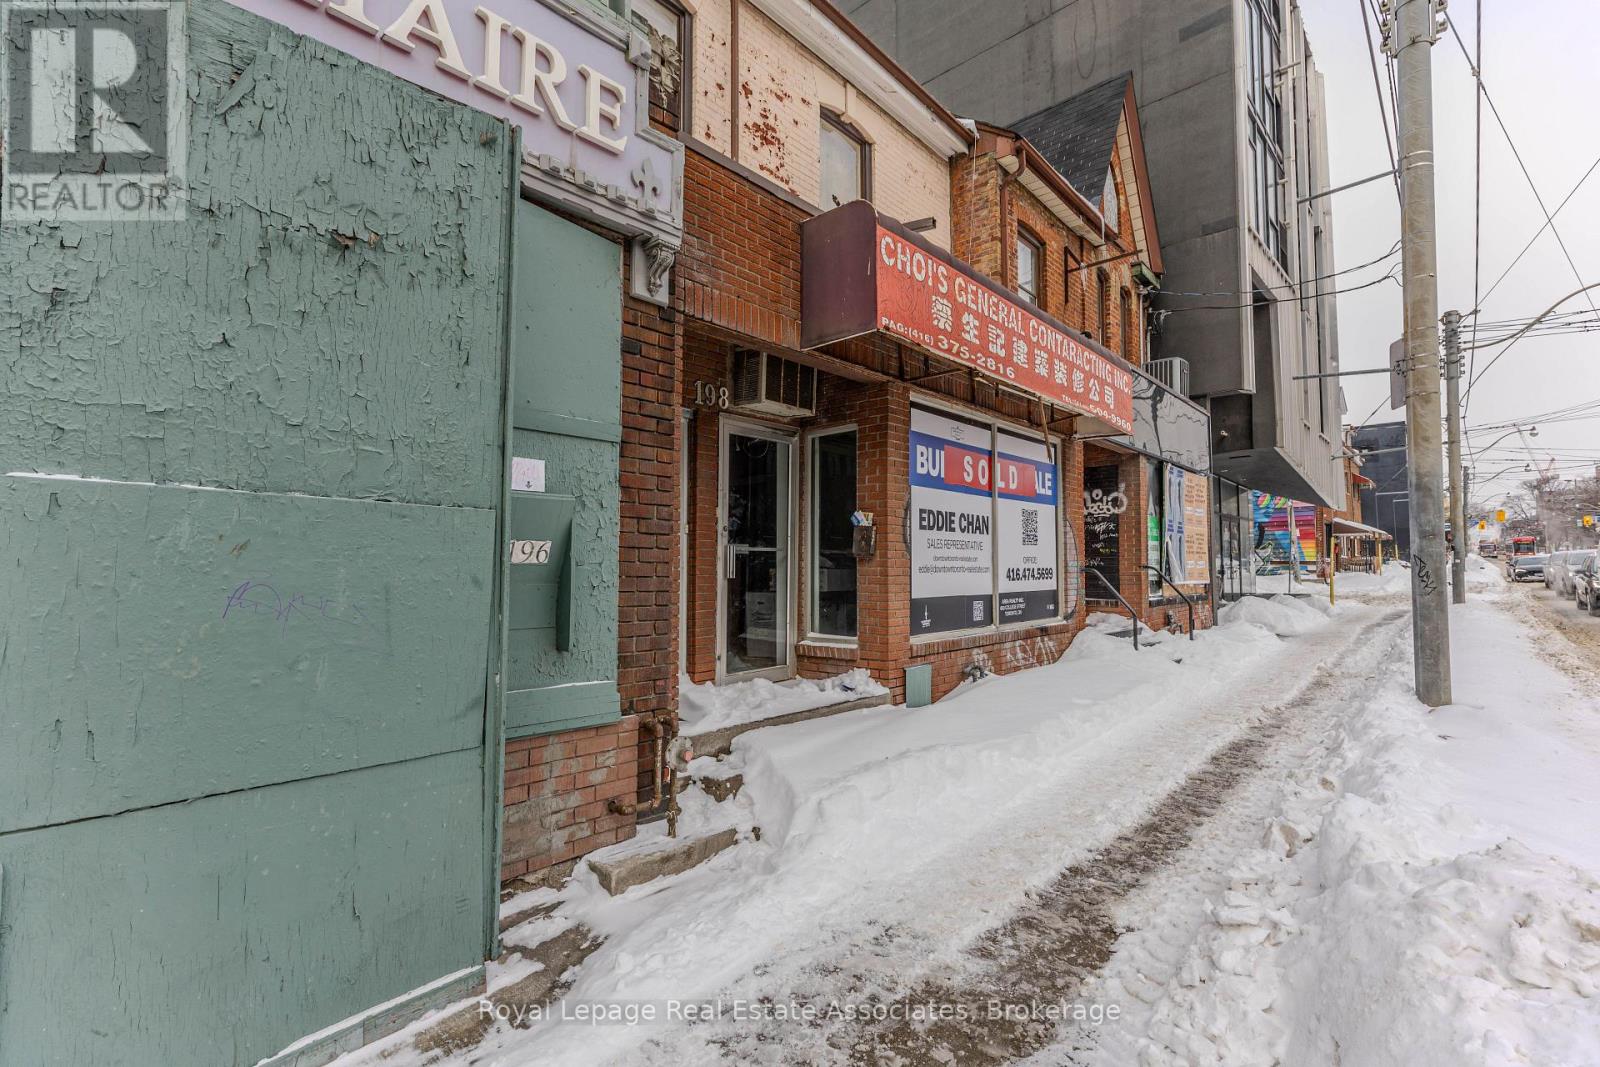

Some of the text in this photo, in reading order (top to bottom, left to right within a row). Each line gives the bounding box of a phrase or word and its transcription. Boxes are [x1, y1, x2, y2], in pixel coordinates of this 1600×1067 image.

[300, 0, 627, 155] AIRE
[880, 235, 948, 294] CHOI'S
[955, 276, 1025, 337] GENERAL
[1029, 318, 1112, 385] CONTARACTING
[938, 334, 1016, 379] 375-2816
[695, 380, 729, 410] 198
[963, 455, 1018, 490] SOLD
[918, 508, 989, 535] EDDIE CHAN
[510, 541, 549, 564] 196
[927, 538, 983, 551] SALES REPRESENTATIVE
